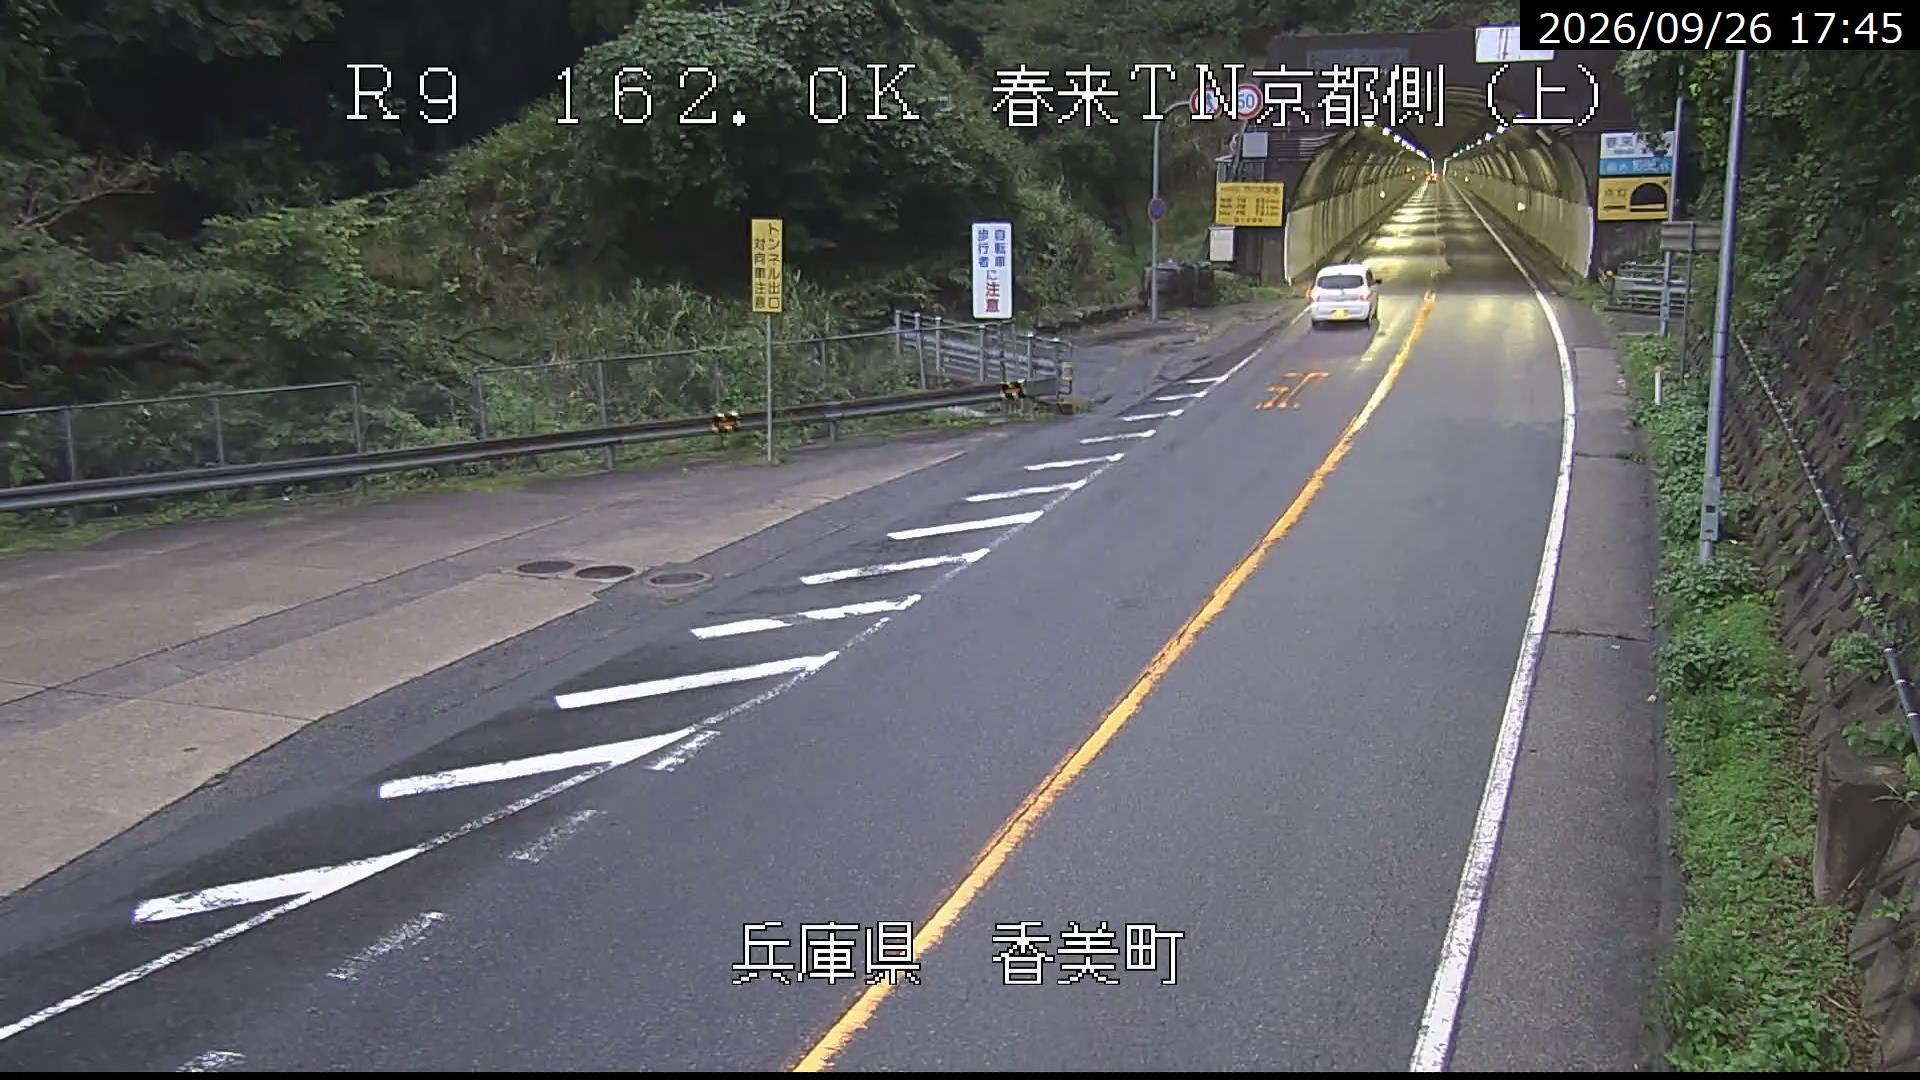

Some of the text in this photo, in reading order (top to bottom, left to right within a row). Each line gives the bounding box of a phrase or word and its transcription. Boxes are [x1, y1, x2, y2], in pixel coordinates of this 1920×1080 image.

[768, 222, 780, 309] トンネル出口
[978, 228, 989, 268] 歩行者
[994, 229, 1006, 268] 自転車
[754, 237, 766, 309] 対向車注意
[985, 269, 1000, 313] に注意
